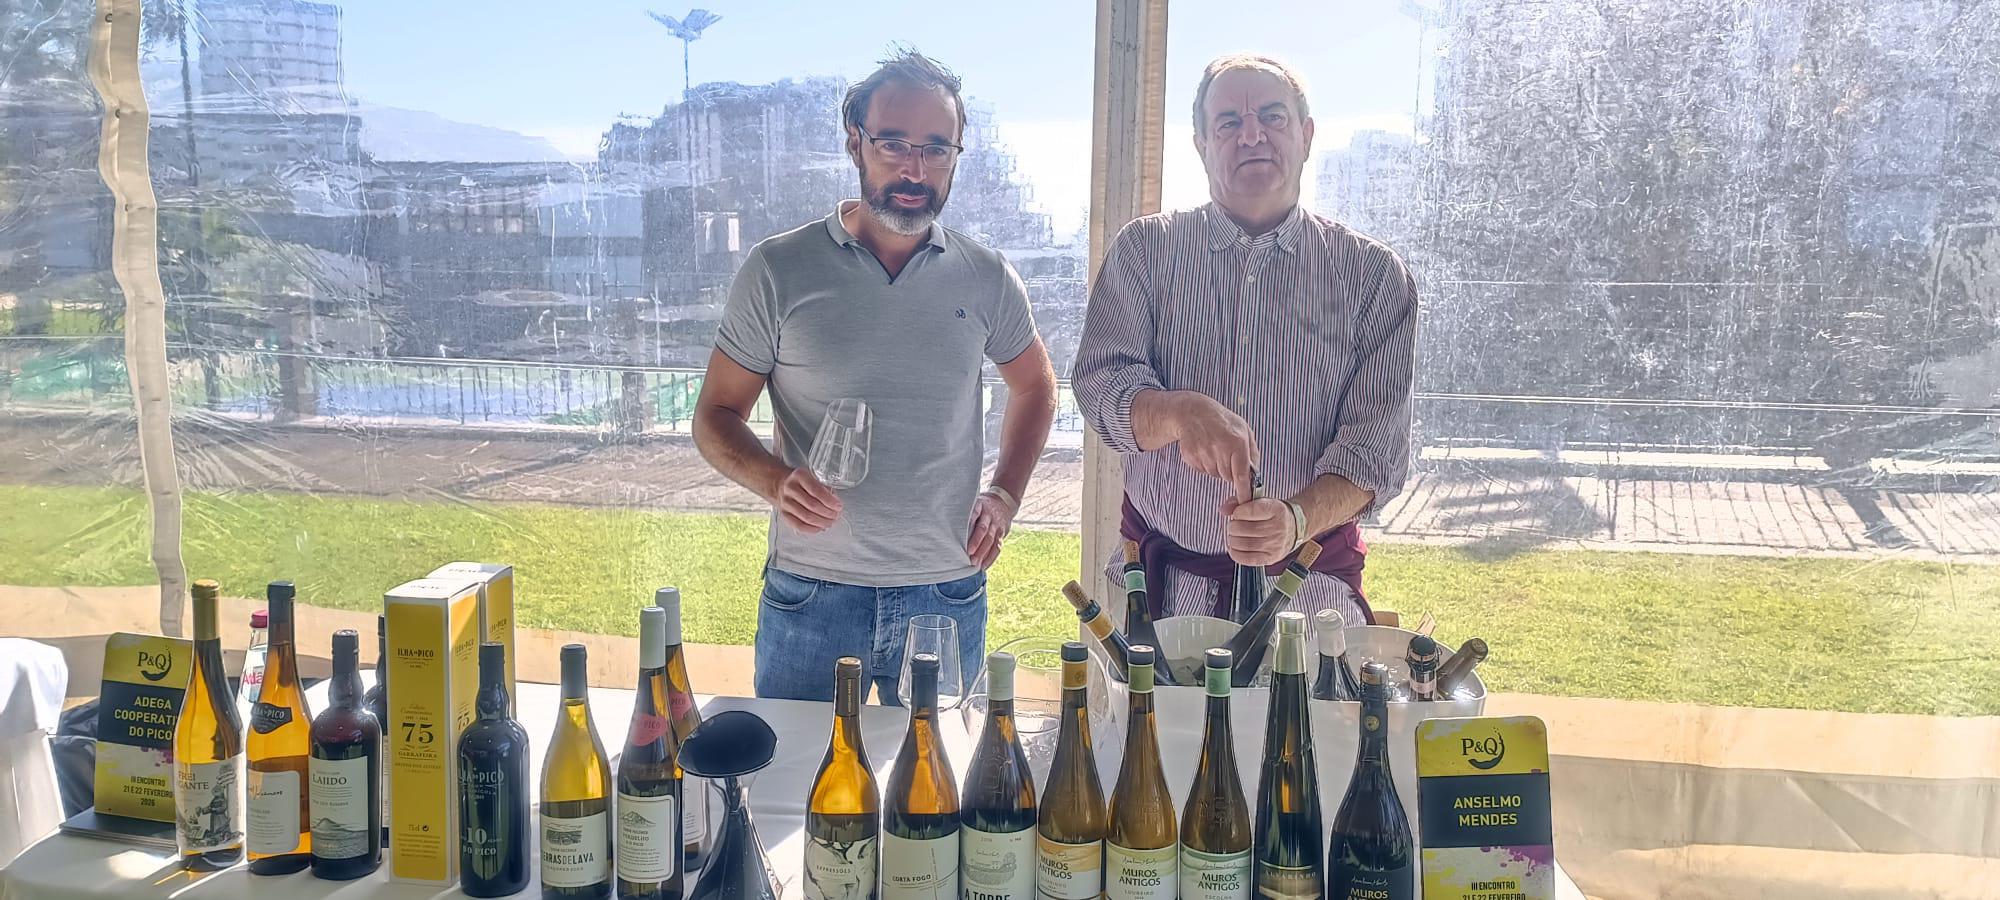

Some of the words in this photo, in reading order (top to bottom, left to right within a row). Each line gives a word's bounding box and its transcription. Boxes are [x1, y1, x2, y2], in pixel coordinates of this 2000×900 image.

[398, 648, 414, 657] ILHA
[136, 652, 166, 670] P&Q
[134, 696, 172, 710] ADEGA
[114, 709, 177, 726] COOPERATI
[129, 726, 144, 737] DO
[146, 728, 172, 740] PICO
[402, 722, 433, 744] 75
[1460, 737, 1497, 755] P&Q
[137, 777, 165, 787] ENCONTRO
[479, 771, 504, 783] PICO
[144, 788, 173, 798] FEVEREIRO
[1454, 796, 1521, 809] ANSELMO
[1459, 814, 1518, 826] MENDES
[467, 828, 487, 844] 10
[475, 848, 496, 856] PICO
[1040, 856, 1068, 870] MUROS
[1122, 868, 1157, 877] MUROS
[1202, 873, 1237, 882] MUROS
[1119, 876, 1160, 886] ANTIGOS
[1198, 881, 1240, 891] ANTIGOS
[1479, 881, 1515, 890] ENCONTRO
[1350, 888, 1388, 899] MUROS
